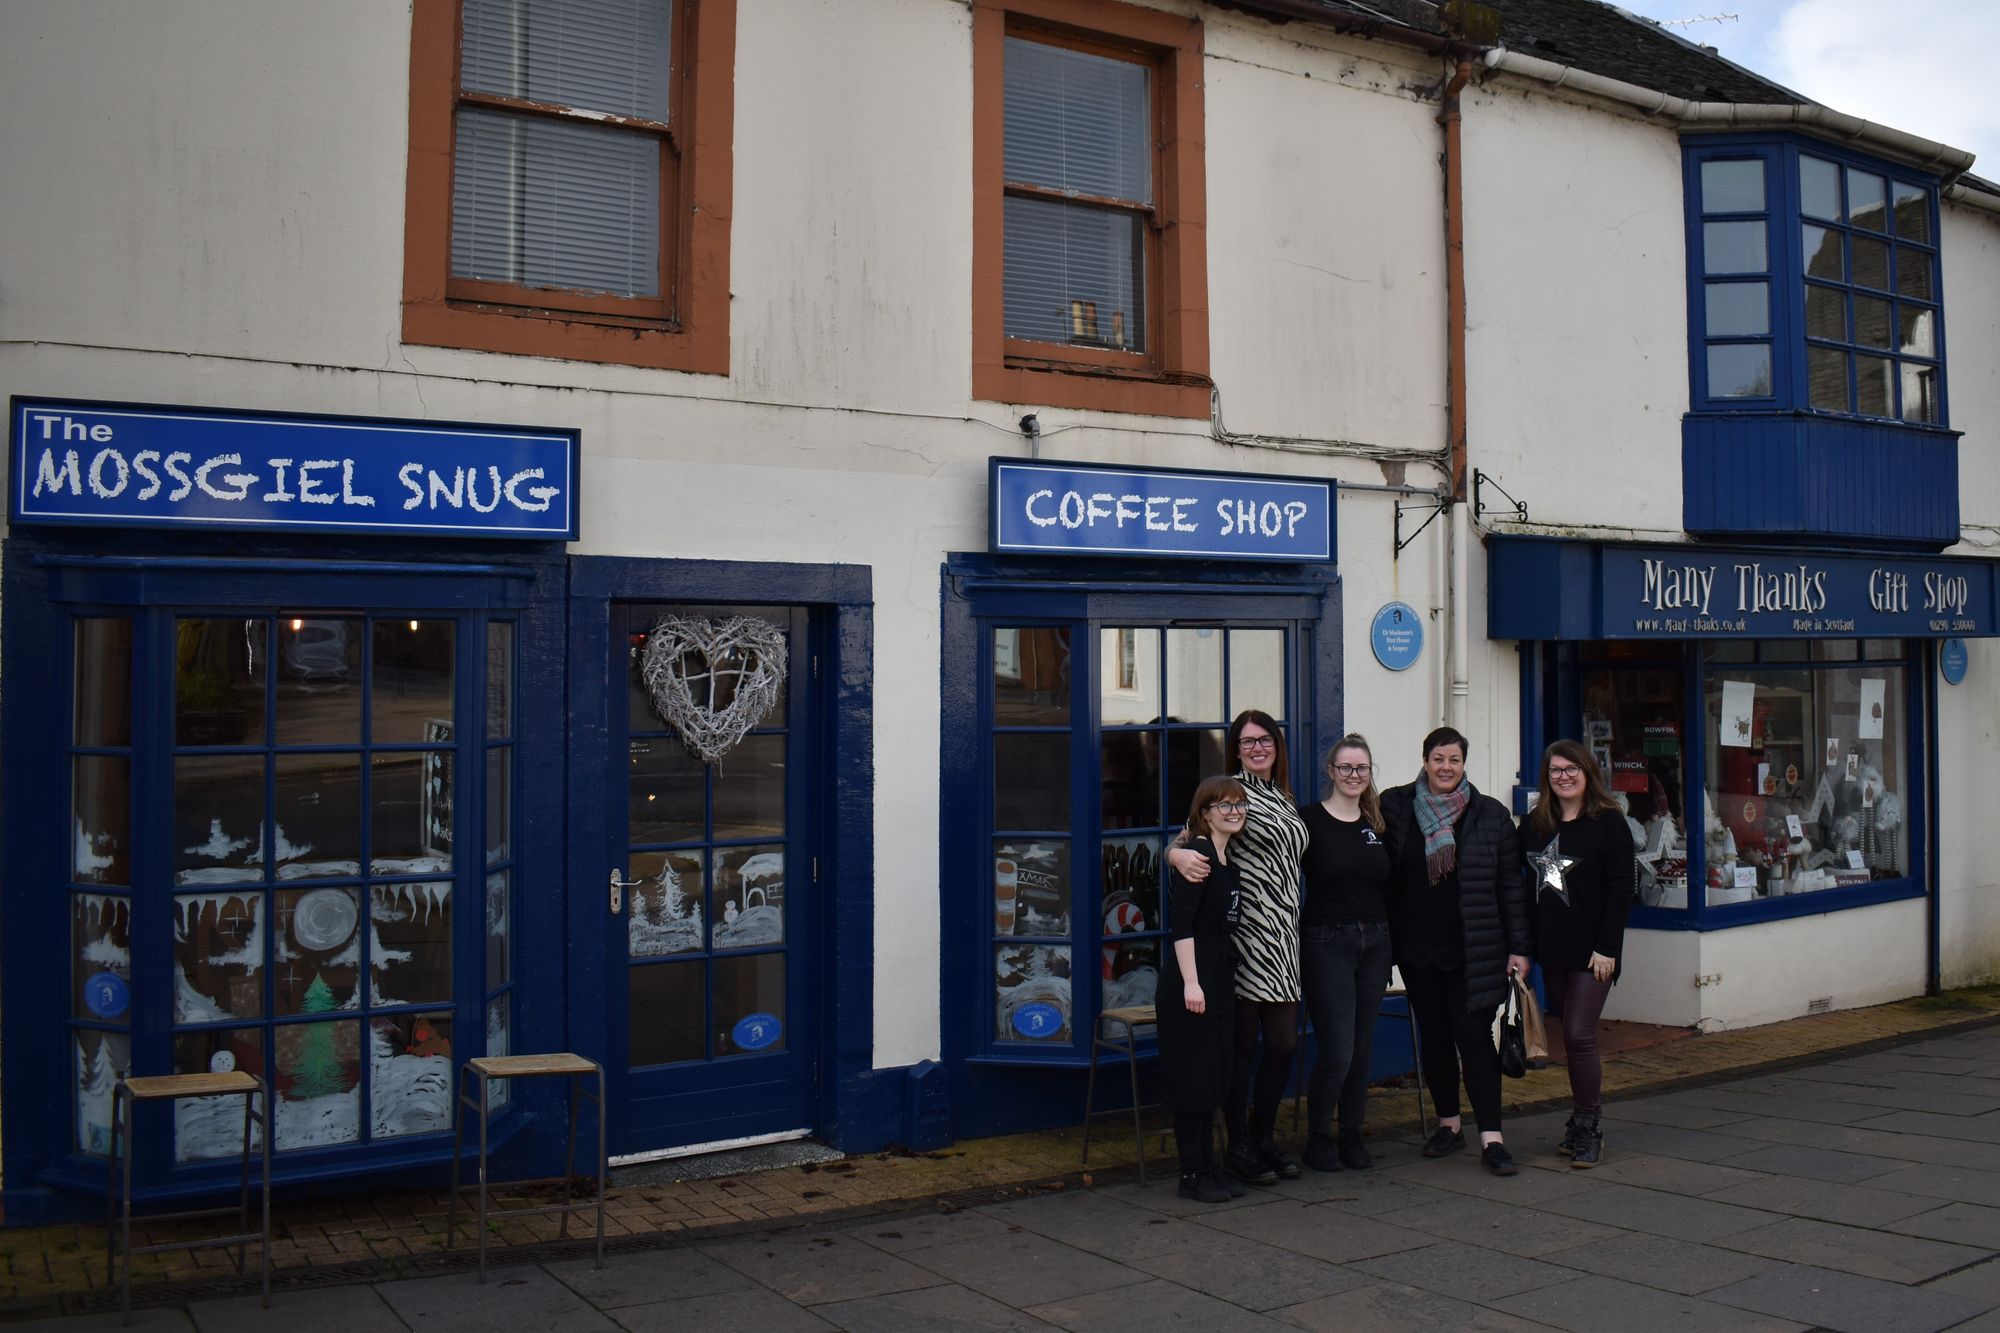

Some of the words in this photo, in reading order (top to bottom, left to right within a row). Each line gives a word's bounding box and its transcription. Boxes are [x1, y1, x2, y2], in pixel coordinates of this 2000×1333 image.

[34, 415, 114, 442] The
[33, 448, 376, 507] MOSSGIEL
[398, 462, 560, 513] SNUG
[1025, 489, 1199, 532] COFFEE
[1216, 499, 1307, 538] SHOP
[1641, 558, 1716, 615] Many
[1734, 563, 1826, 614] Thanks
[1869, 567, 1909, 613] Gift
[1923, 571, 1967, 615] Shop
